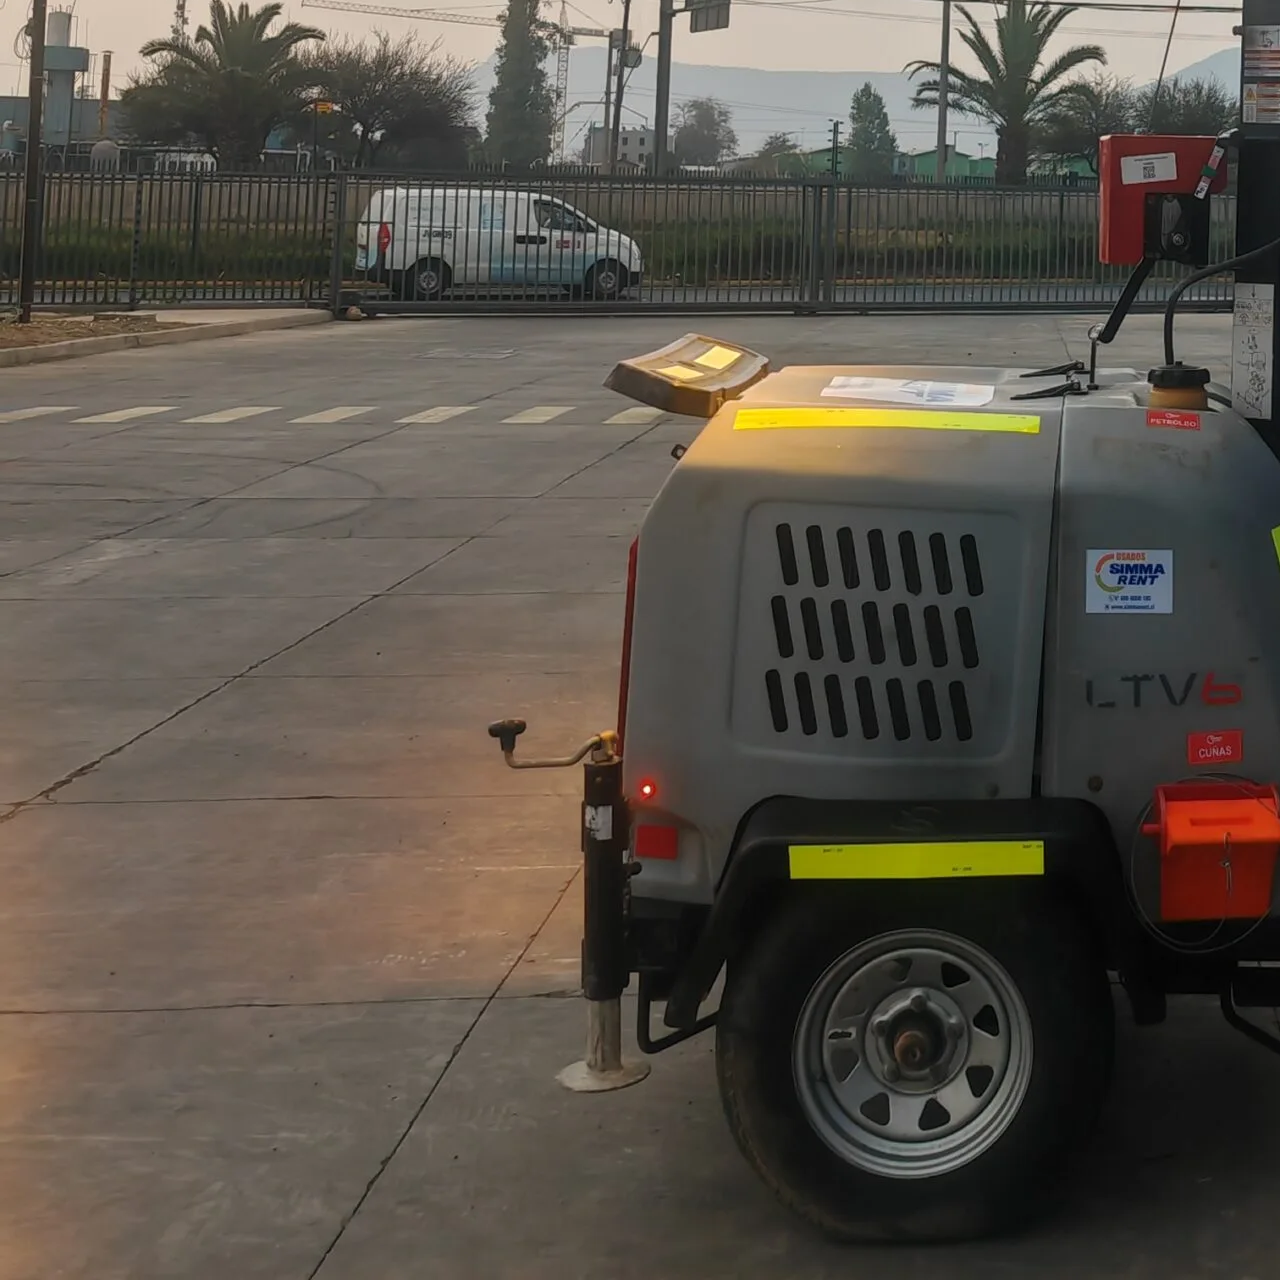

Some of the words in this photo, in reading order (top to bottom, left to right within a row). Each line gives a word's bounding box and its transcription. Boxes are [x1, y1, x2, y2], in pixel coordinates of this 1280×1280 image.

[1109, 563, 1165, 575] SIMMA
[1117, 575, 1159, 585] RENT
[1086, 672, 1243, 708] LTV6
[1199, 745, 1232, 759] CUÑAS
